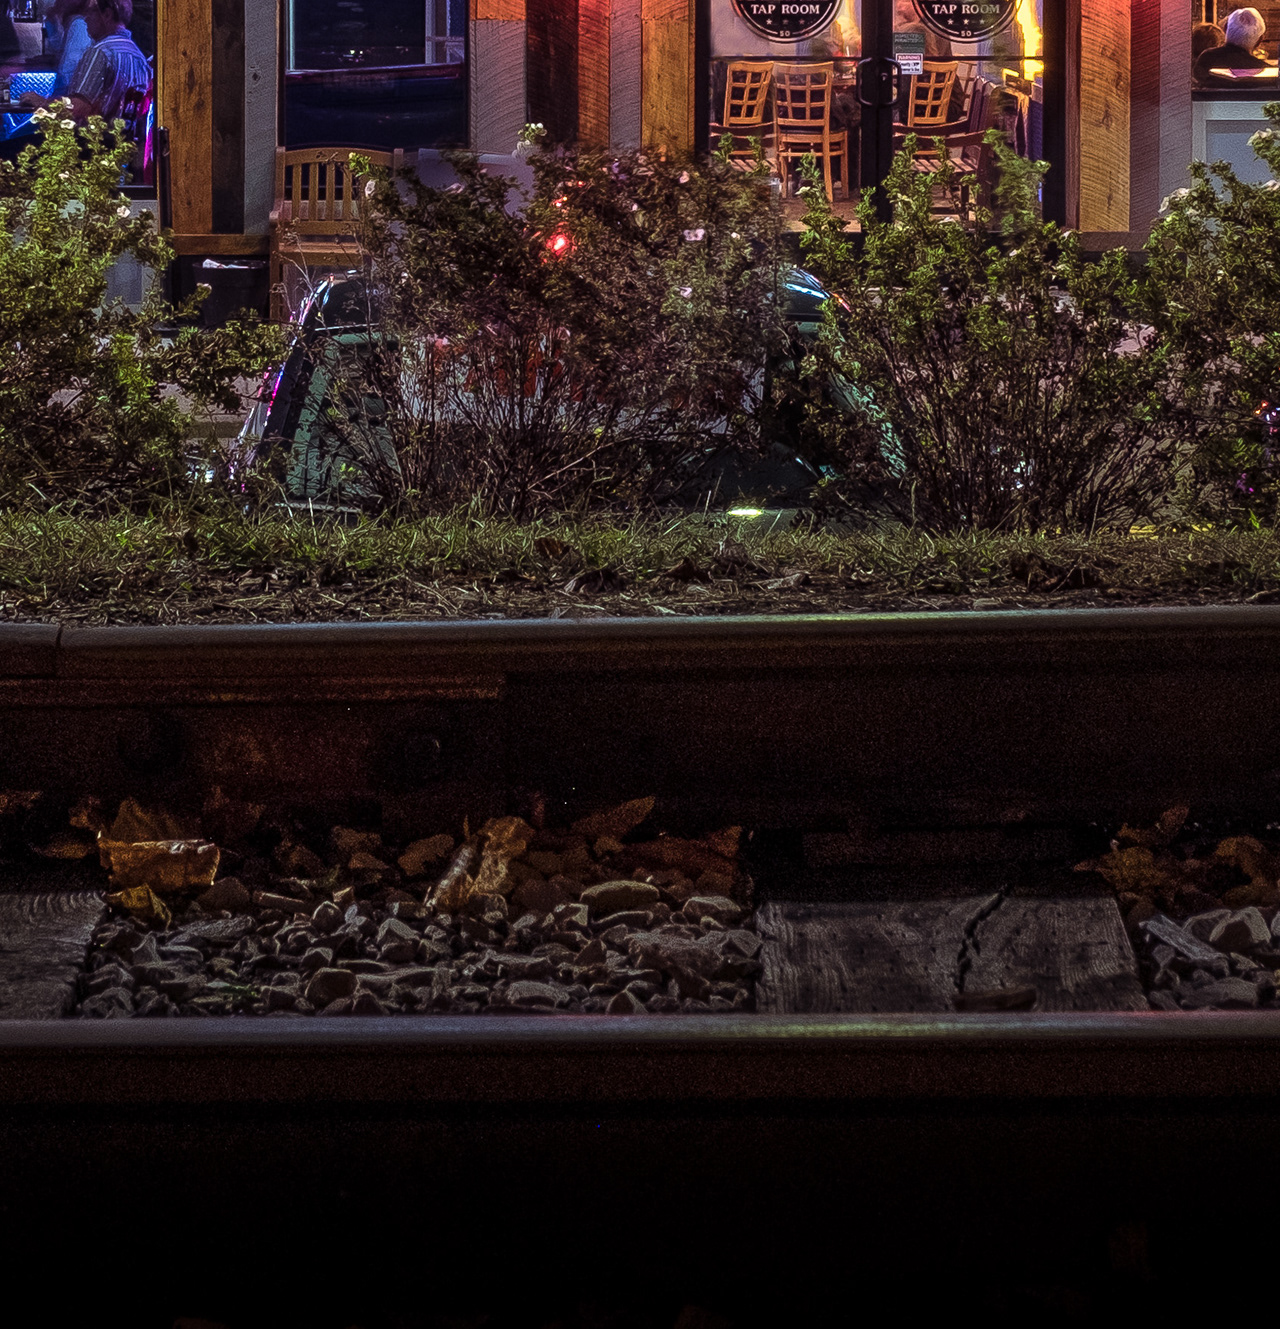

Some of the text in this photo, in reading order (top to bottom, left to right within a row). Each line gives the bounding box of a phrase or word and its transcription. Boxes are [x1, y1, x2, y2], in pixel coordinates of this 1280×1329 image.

[750, 4, 820, 15] TAP ROOM
[932, 4, 1000, 15] TAP ROOM
